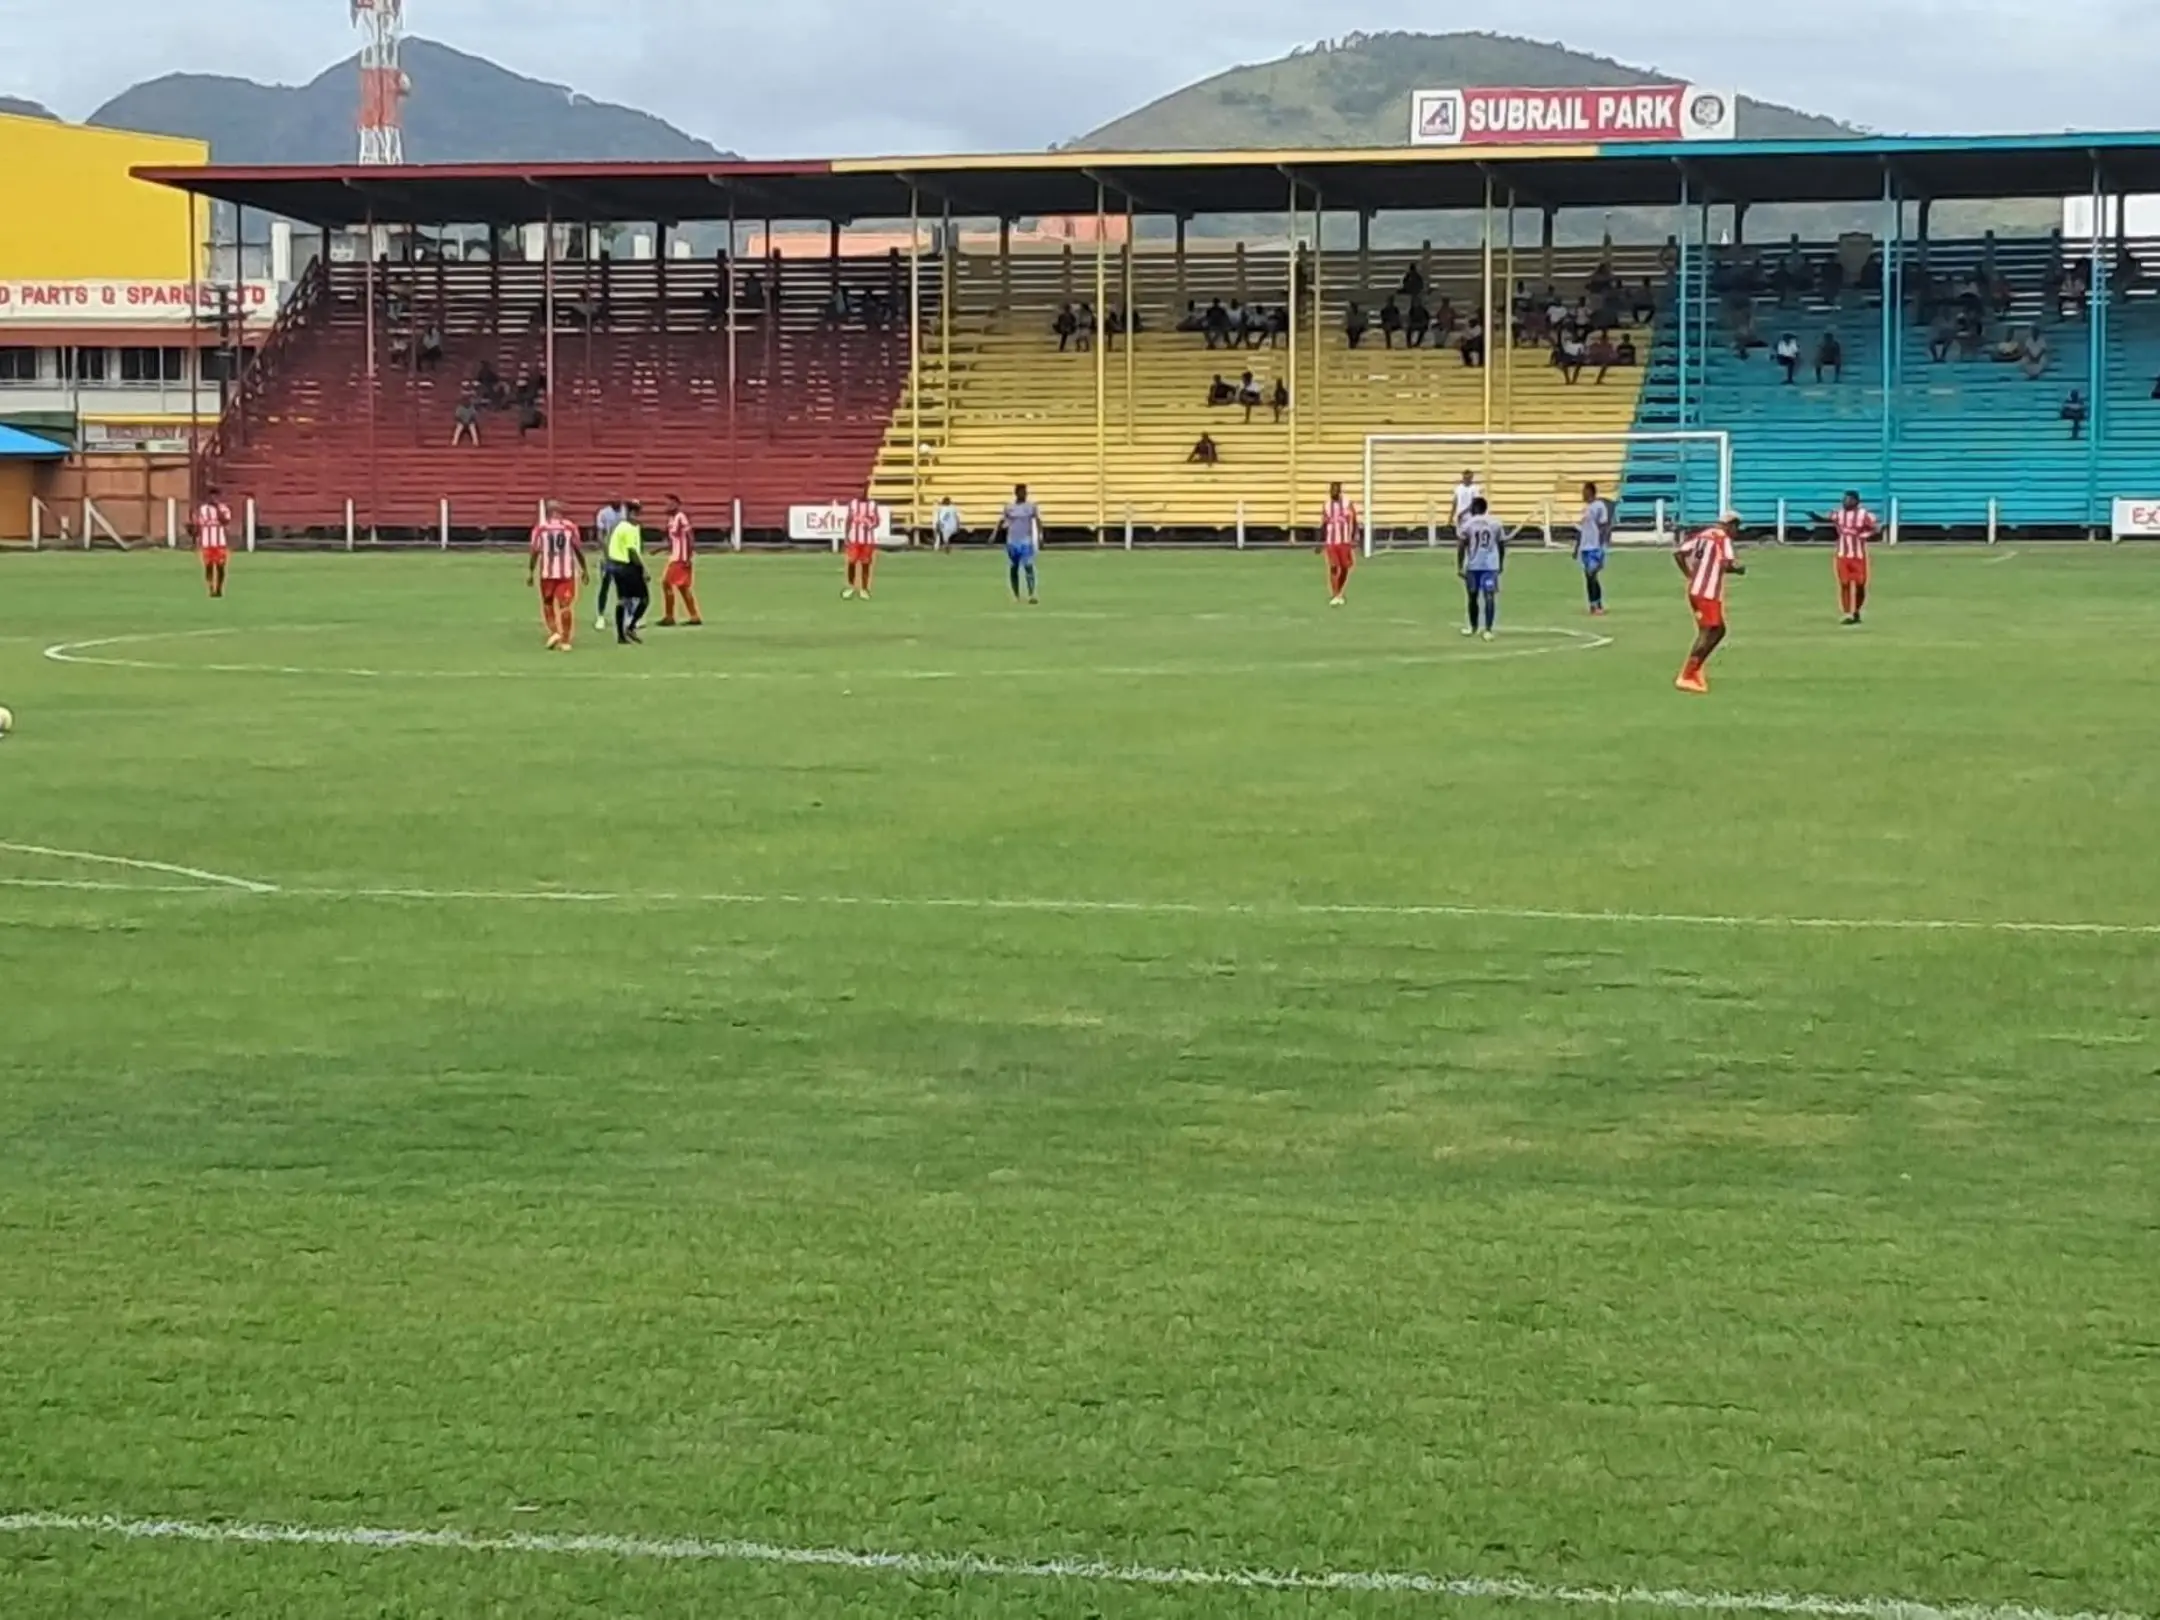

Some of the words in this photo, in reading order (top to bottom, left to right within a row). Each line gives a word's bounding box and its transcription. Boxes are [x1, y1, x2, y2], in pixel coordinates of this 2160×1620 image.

[1469, 97, 1590, 131] SUBRAIL
[1598, 95, 1676, 129] PARK
[21, 285, 88, 305] PARTS
